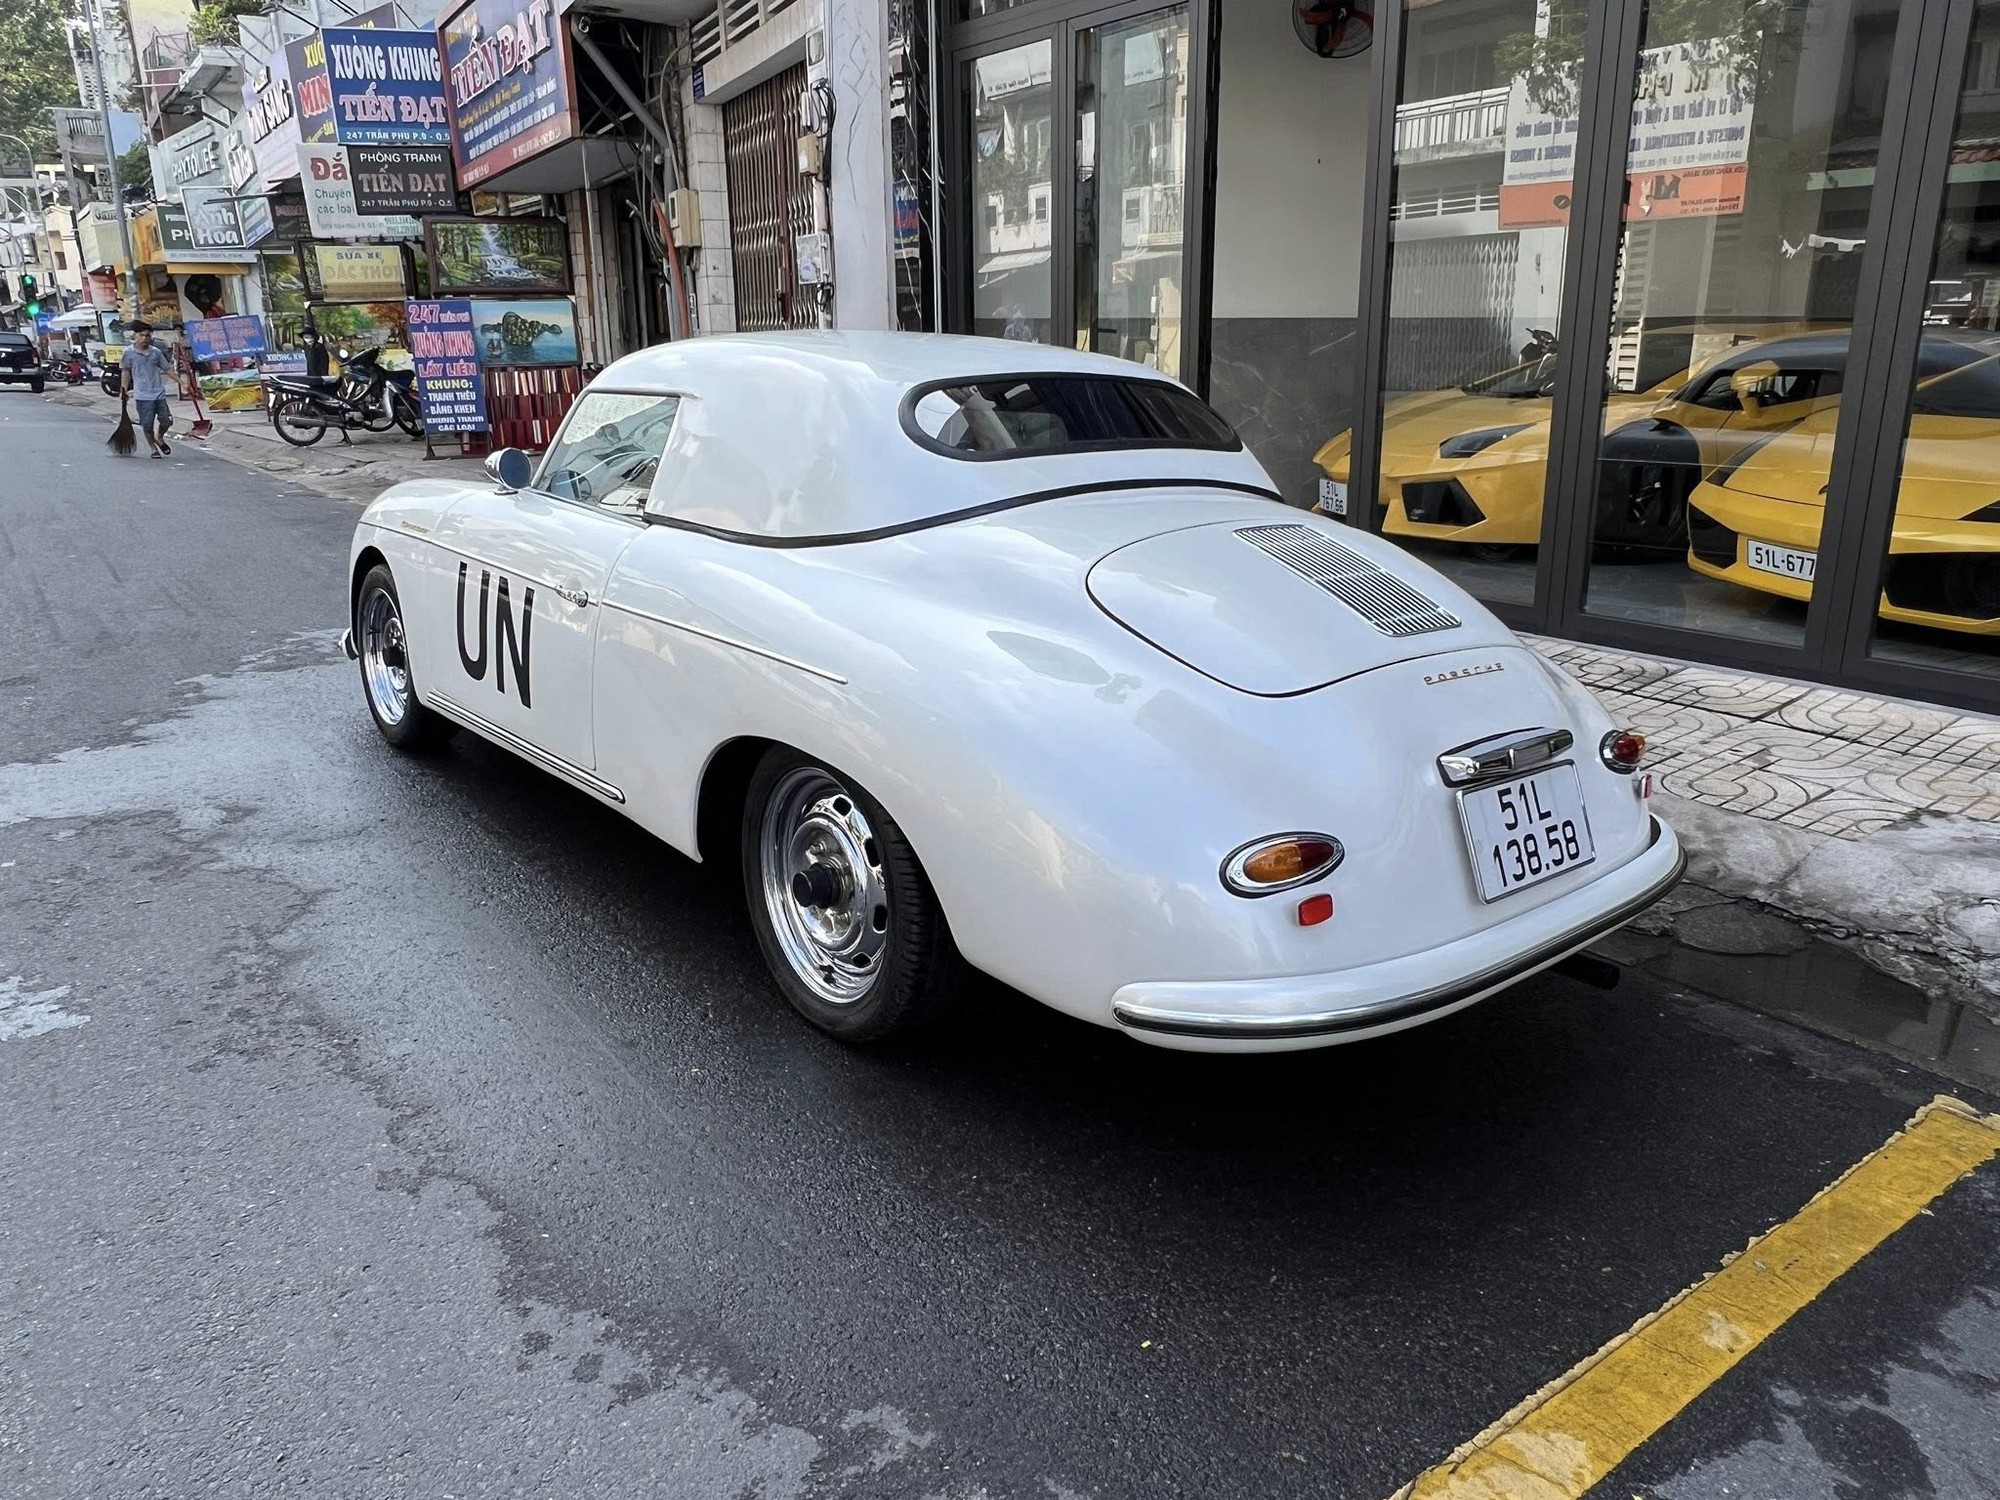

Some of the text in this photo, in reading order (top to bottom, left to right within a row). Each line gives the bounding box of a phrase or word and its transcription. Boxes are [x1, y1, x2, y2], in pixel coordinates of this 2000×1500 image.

[388, 46, 441, 82] KHUNG
[339, 82, 396, 122] TIẾN
[400, 96, 447, 129] ĐẠT
[346, 131, 362, 140] 247
[359, 151, 442, 163] PHÒNG TRANH
[358, 164, 403, 193] TIẾN
[408, 173, 447, 197] ĐẠT
[361, 199, 375, 207] 247
[408, 304, 440, 324] 247
[443, 330, 475, 357] KHUNG
[428, 391, 454, 402] TRANH
[454, 404, 476, 414] KHEN
[456, 560, 535, 709] UN
[1423, 662, 1504, 685] PORSCHE
[1497, 780, 1552, 831] 51L
[1493, 819, 1580, 888] 138.58
